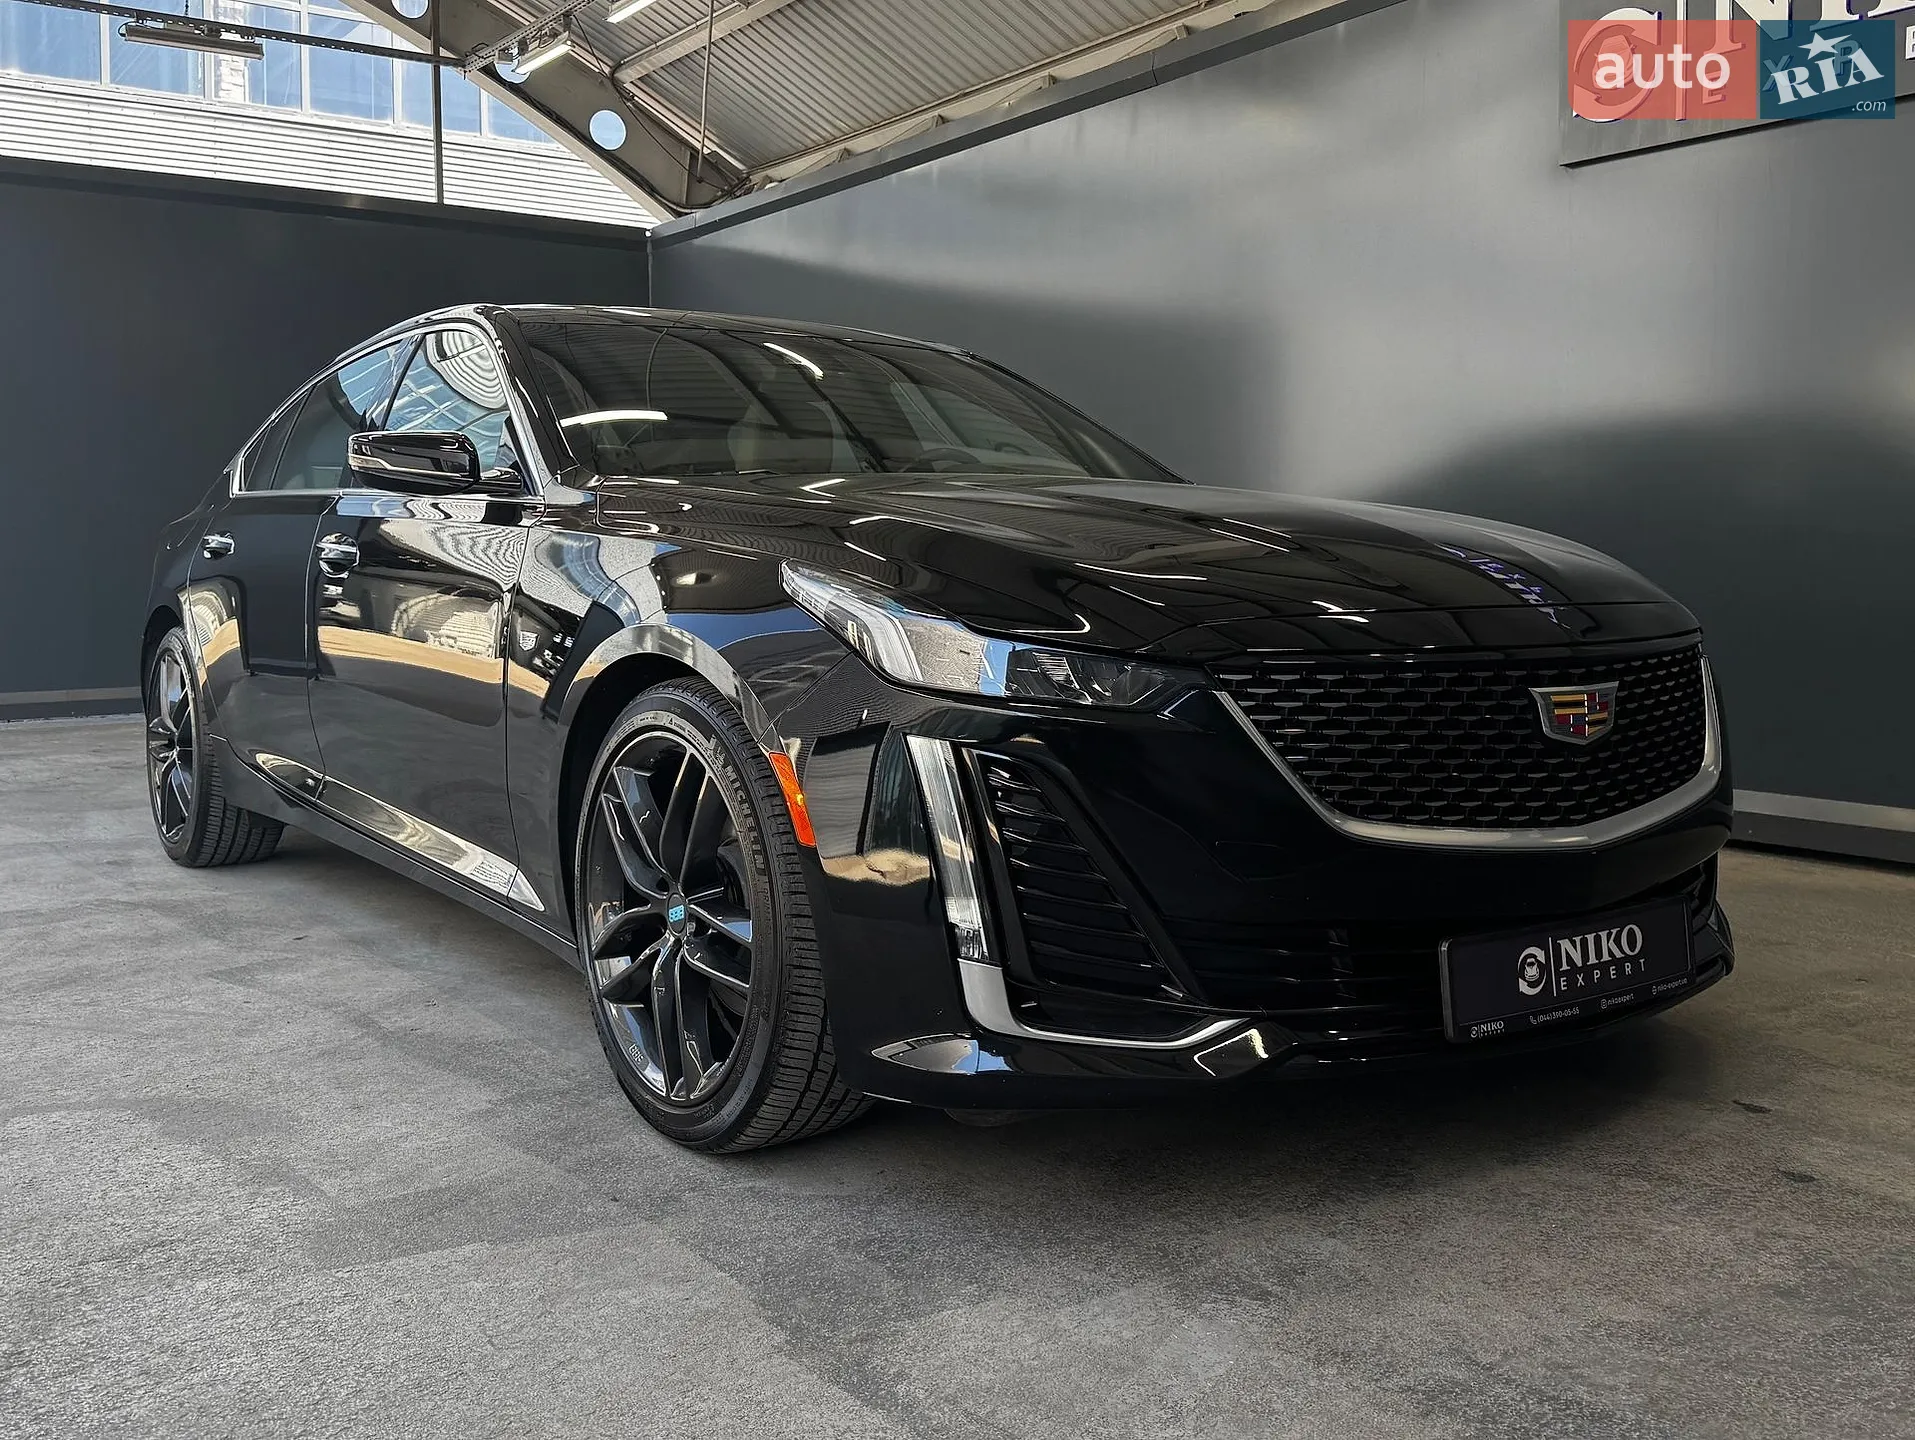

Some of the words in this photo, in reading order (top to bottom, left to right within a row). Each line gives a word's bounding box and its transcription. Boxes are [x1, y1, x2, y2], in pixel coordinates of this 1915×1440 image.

[724, 764, 767, 872] MICHELIN
[1556, 923, 1643, 972] NIKO
[1560, 958, 1647, 991] EXPERT
[1480, 1020, 1504, 1033] NIKO
